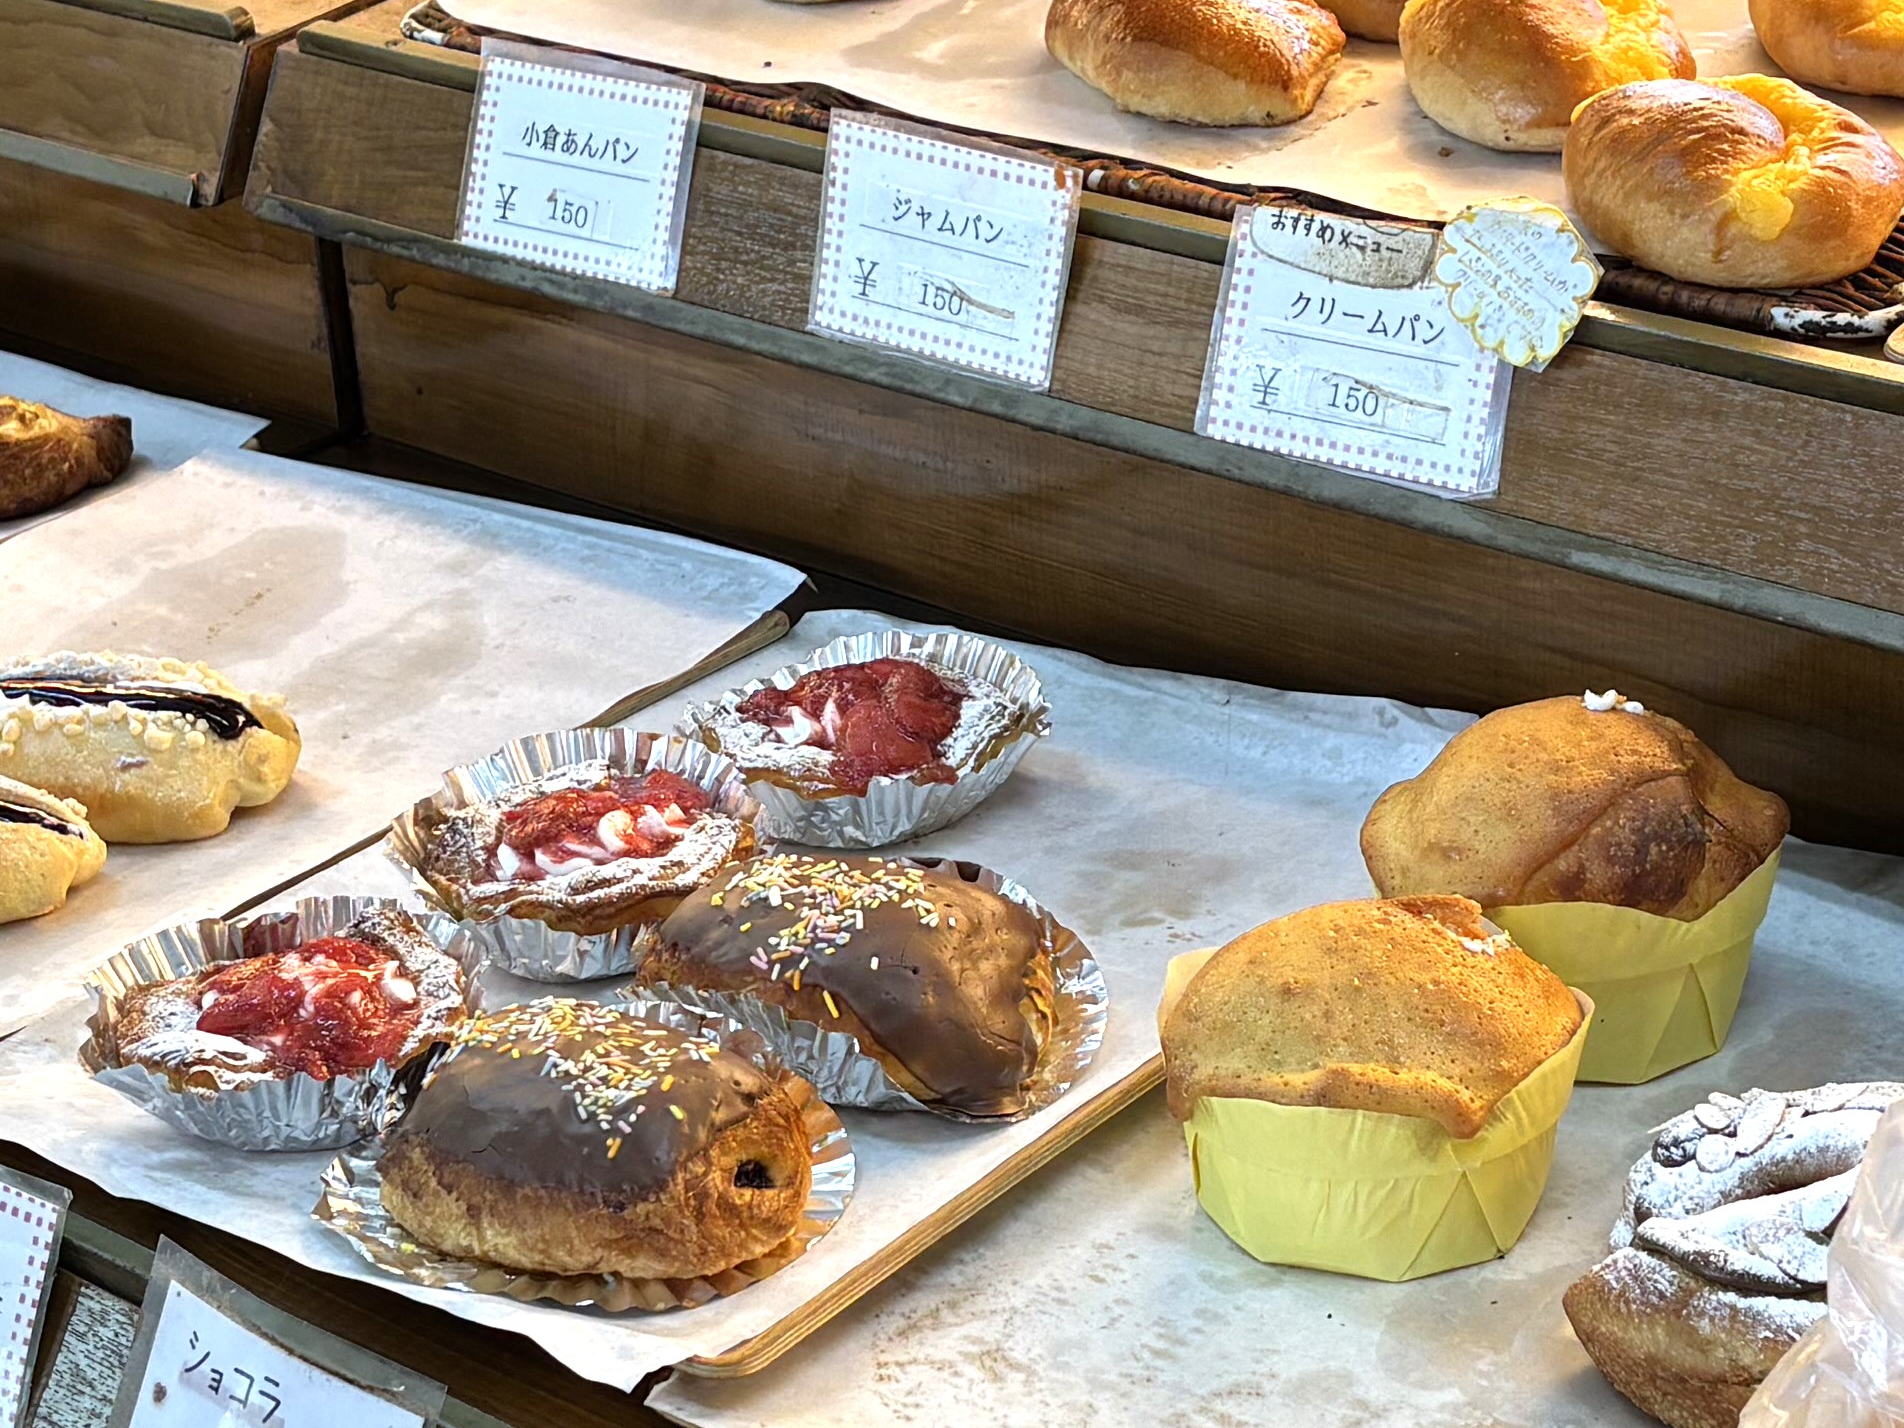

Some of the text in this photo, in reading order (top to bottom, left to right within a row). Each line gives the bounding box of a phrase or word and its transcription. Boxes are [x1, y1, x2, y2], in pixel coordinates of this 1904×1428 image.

[521, 121, 640, 167] 小倉あんパン
[546, 195, 590, 230] 150
[891, 195, 1004, 244] ジャムパン
[1270, 210, 1404, 255] おすすめメニュー
[917, 283, 965, 317] 150
[1289, 291, 1446, 345] クリームパン
[1328, 382, 1379, 418] 150
[183, 1330, 281, 1424] ショコラ
